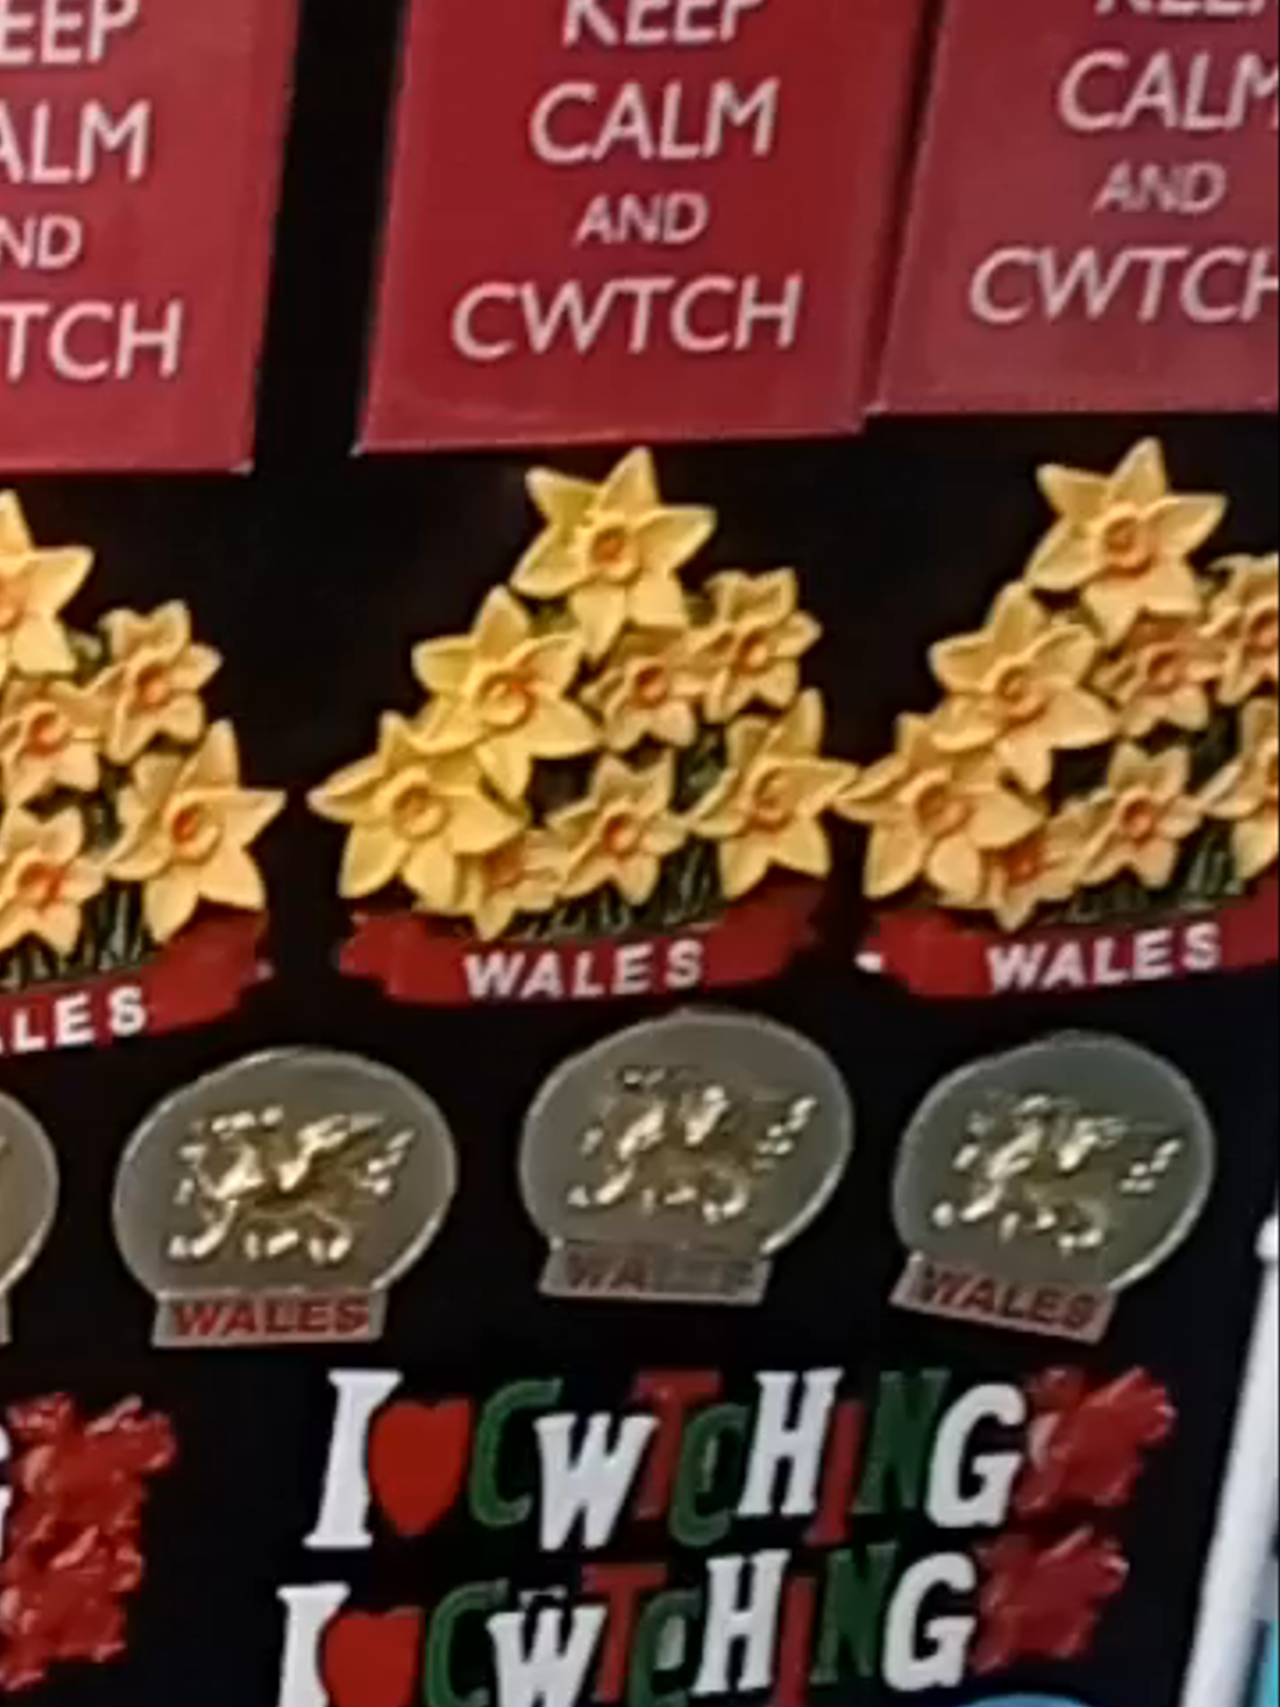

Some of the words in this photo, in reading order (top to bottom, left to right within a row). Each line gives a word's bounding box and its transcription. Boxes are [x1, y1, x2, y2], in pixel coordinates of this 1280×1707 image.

[529, 78, 780, 164] CALM
[573, 193, 709, 247] AND
[1093, 162, 1228, 214] AND
[450, 274, 803, 362] CWTCH
[462, 936, 706, 1002] WALES
[986, 922, 1224, 993] WALES
[170, 1294, 369, 1337] WALES
[917, 1256, 1101, 1331] WALES
[304, 1368, 404, 1549] I
[468, 1366, 1029, 1551] CWTCHING
